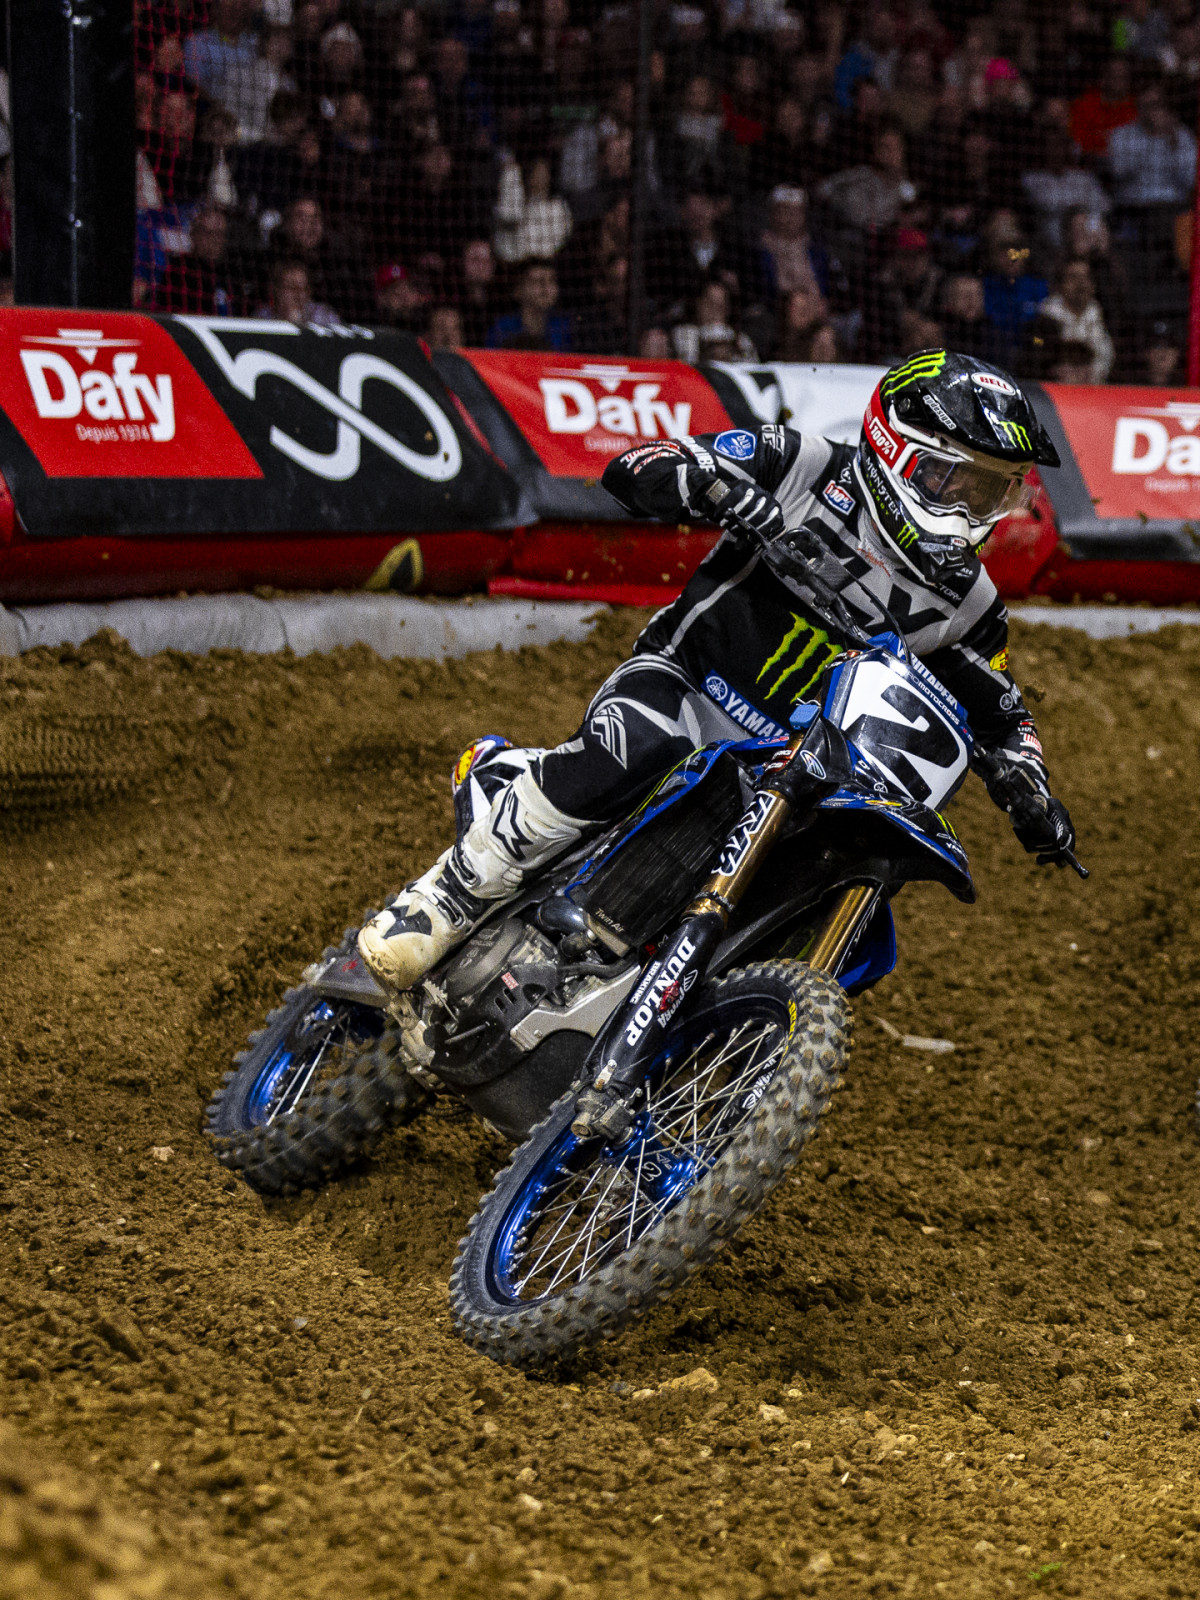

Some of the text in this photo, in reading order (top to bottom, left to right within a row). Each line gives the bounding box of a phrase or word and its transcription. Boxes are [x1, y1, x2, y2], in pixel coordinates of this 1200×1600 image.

[20, 349, 176, 443] Dafy
[979, 375, 1009, 392] BELL
[538, 377, 692, 439] Dafy
[75, 423, 118, 444] Depuis
[869, 425, 891, 456] 100%
[825, 482, 851, 511] 100%
[865, 456, 900, 521] MONSTER
[724, 691, 790, 738] YAMA
[844, 684, 960, 802] 2
[595, 908, 626, 935] Twin Air
[626, 936, 696, 1047] DUNLOP
